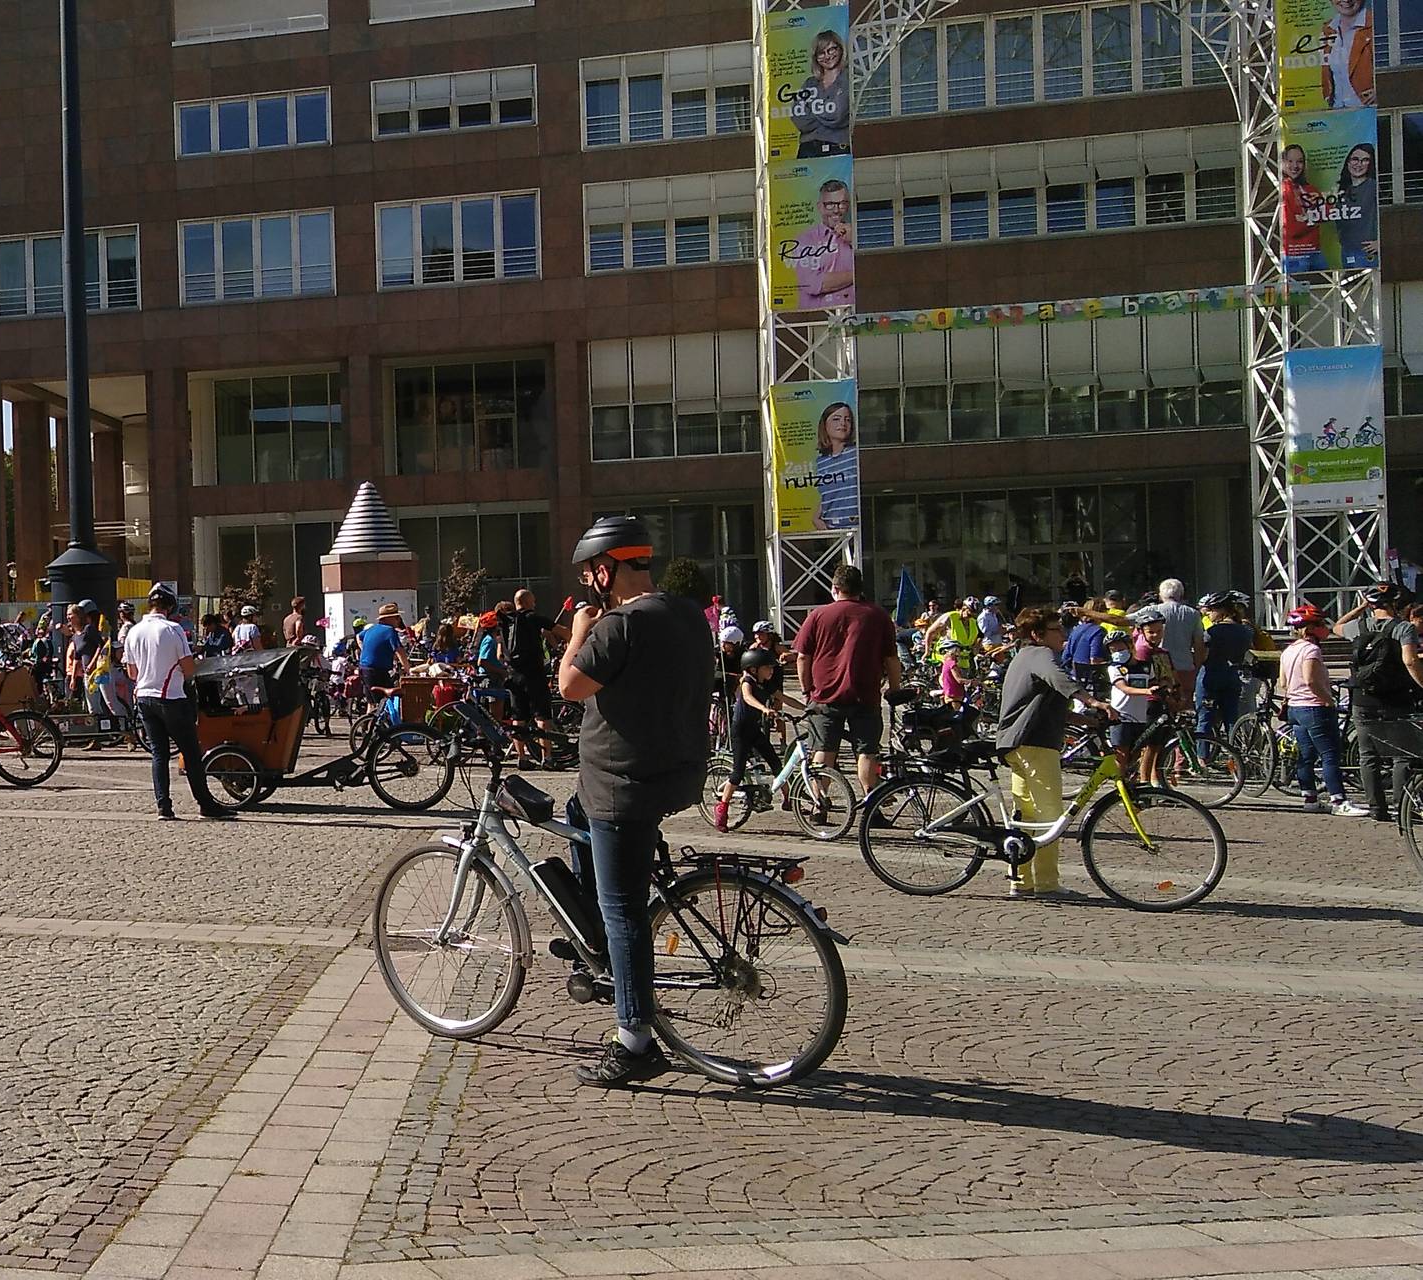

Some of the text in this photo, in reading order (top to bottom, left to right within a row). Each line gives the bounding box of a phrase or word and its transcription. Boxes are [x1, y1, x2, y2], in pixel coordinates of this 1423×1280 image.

[811, 98, 837, 115] Go
[1307, 204, 1362, 226] platz
[778, 234, 837, 261] Rad
[785, 471, 845, 489] nutzen
